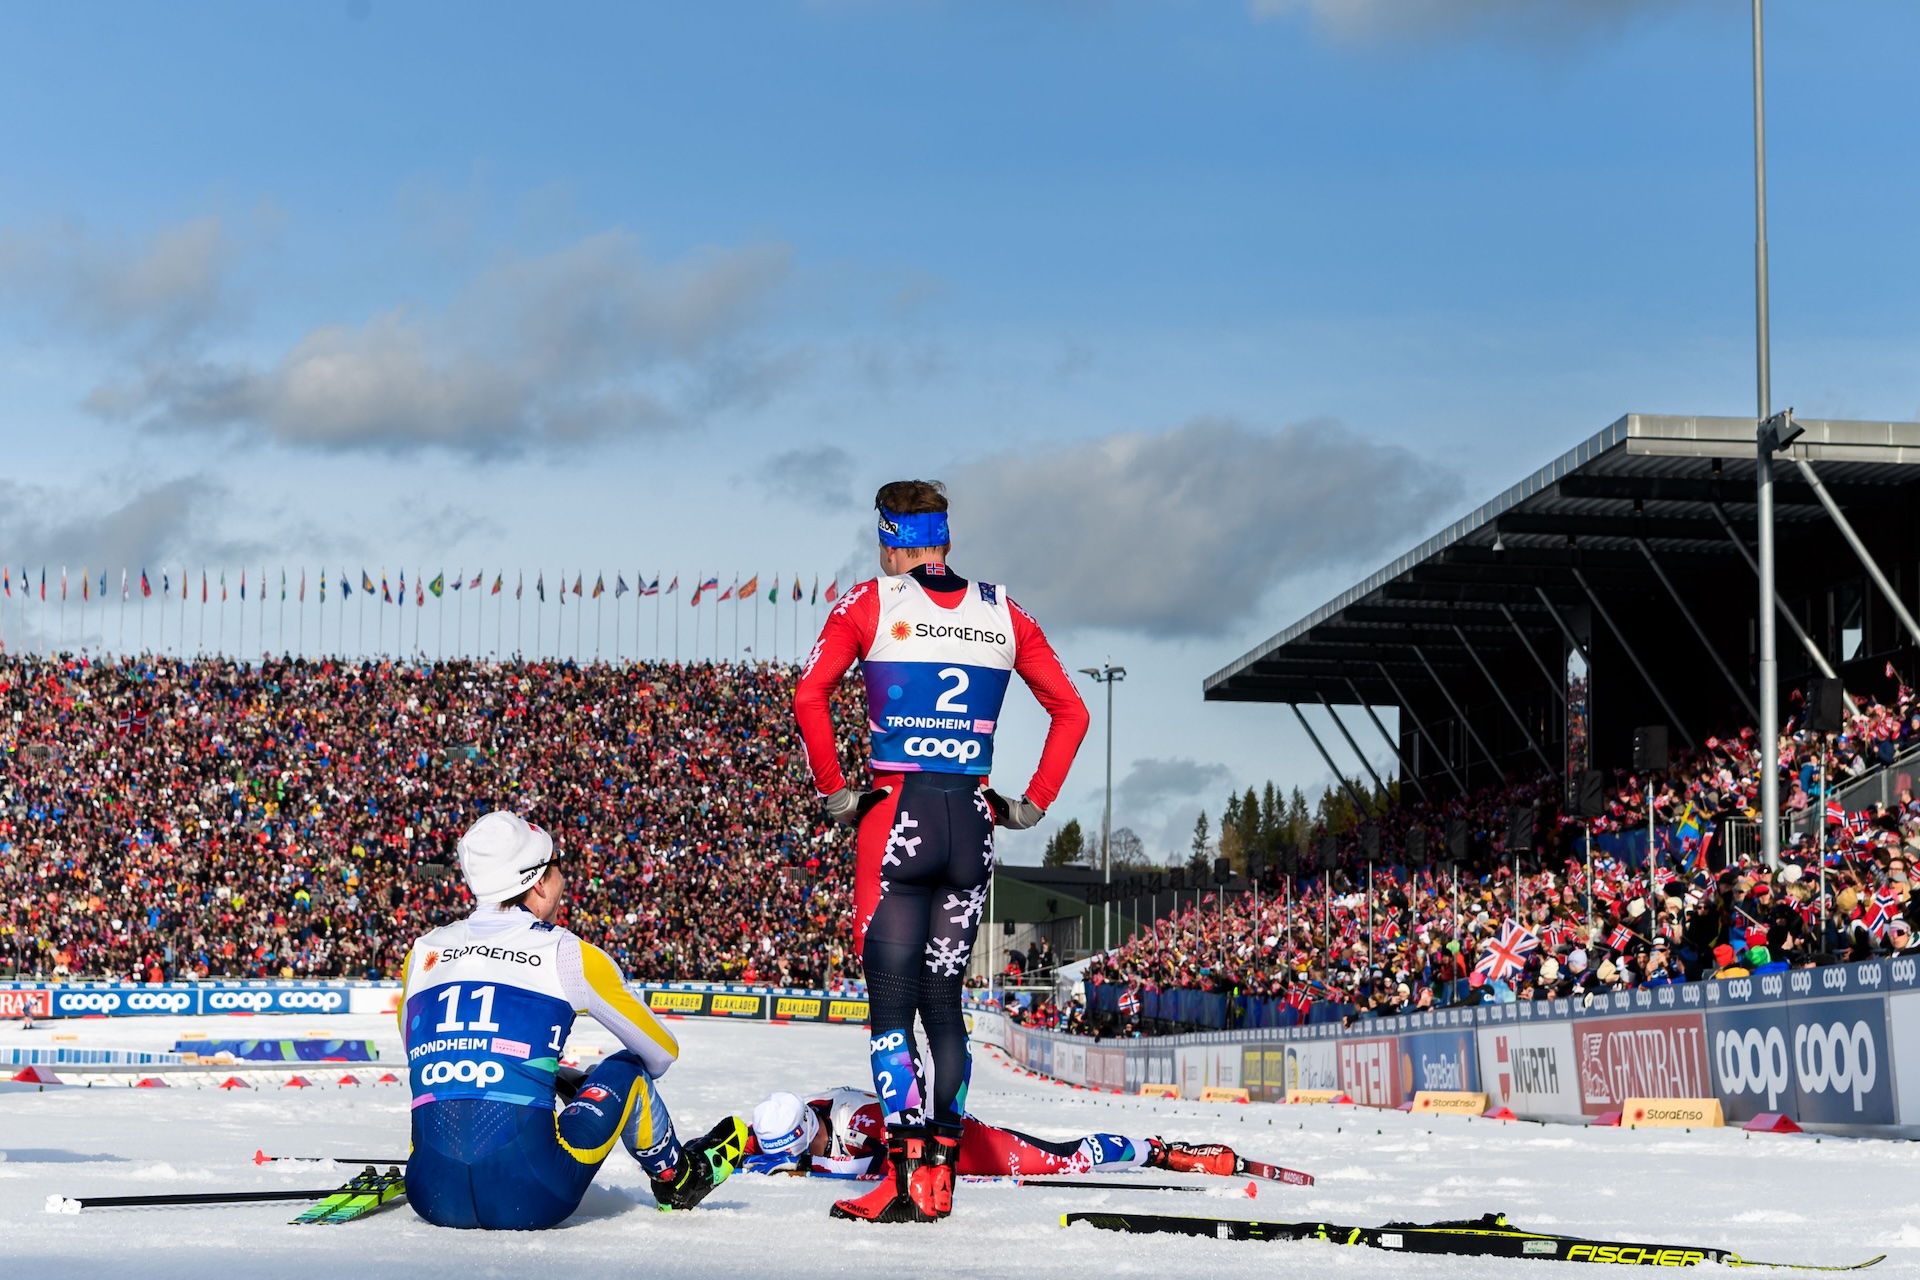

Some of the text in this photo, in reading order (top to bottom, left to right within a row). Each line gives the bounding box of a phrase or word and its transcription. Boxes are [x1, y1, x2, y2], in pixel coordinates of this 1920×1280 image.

[915, 623, 1007, 645] StoraEnso
[935, 667, 970, 713] 2
[886, 716, 971, 730] TRONDHEIM
[904, 736, 981, 764] coop
[441, 945, 541, 967] StoraEnso
[1682, 985, 1700, 1006] coop
[1728, 978, 1752, 1002] coop
[1762, 975, 1782, 998] coop
[1791, 971, 1812, 995] coop
[1823, 967, 1847, 992] coop
[1858, 963, 1882, 989] coop
[1892, 959, 1916, 985] coop
[59, 992, 191, 1013] coop coop
[209, 992, 342, 1012] coop coop
[436, 985, 500, 1033] 11
[410, 1037, 487, 1061] TRONDHEIM
[870, 1032, 904, 1055] oop
[421, 1060, 505, 1088] coop
[1341, 1042, 1392, 1105] ELTEN
[1422, 1053, 1461, 1091] SpareBank
[1607, 1027, 1702, 1104] GENERALI
[1716, 1020, 1876, 1112] coop coop
[878, 1071, 897, 1099] 2
[1432, 1099, 1476, 1108] StoraEnso
[1647, 1109, 1703, 1120] StoraEnso
[761, 1134, 796, 1149] SpareBank
[840, 1201, 870, 1215] ATOMIC
[1566, 1244, 1705, 1267] FISCHER
